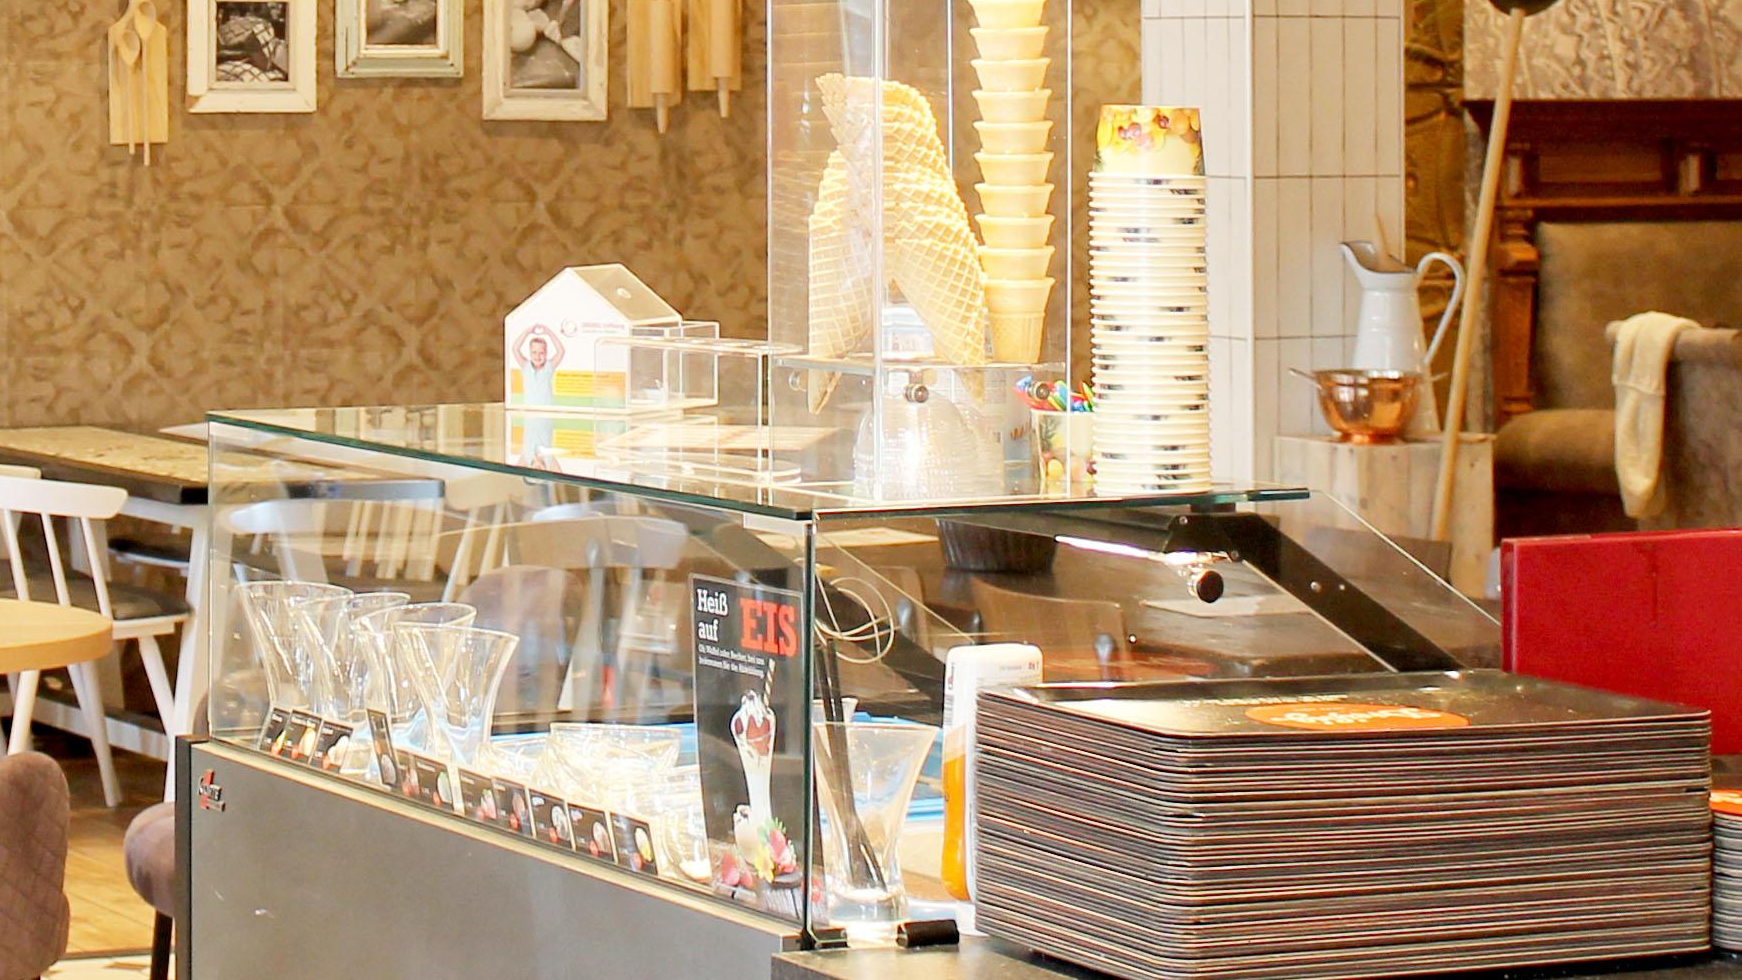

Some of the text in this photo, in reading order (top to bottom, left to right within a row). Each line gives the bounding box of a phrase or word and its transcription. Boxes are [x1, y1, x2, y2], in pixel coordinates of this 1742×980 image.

[696, 588, 728, 616] Heiß
[698, 618, 718, 642] auf
[739, 597, 797, 657] EIS
